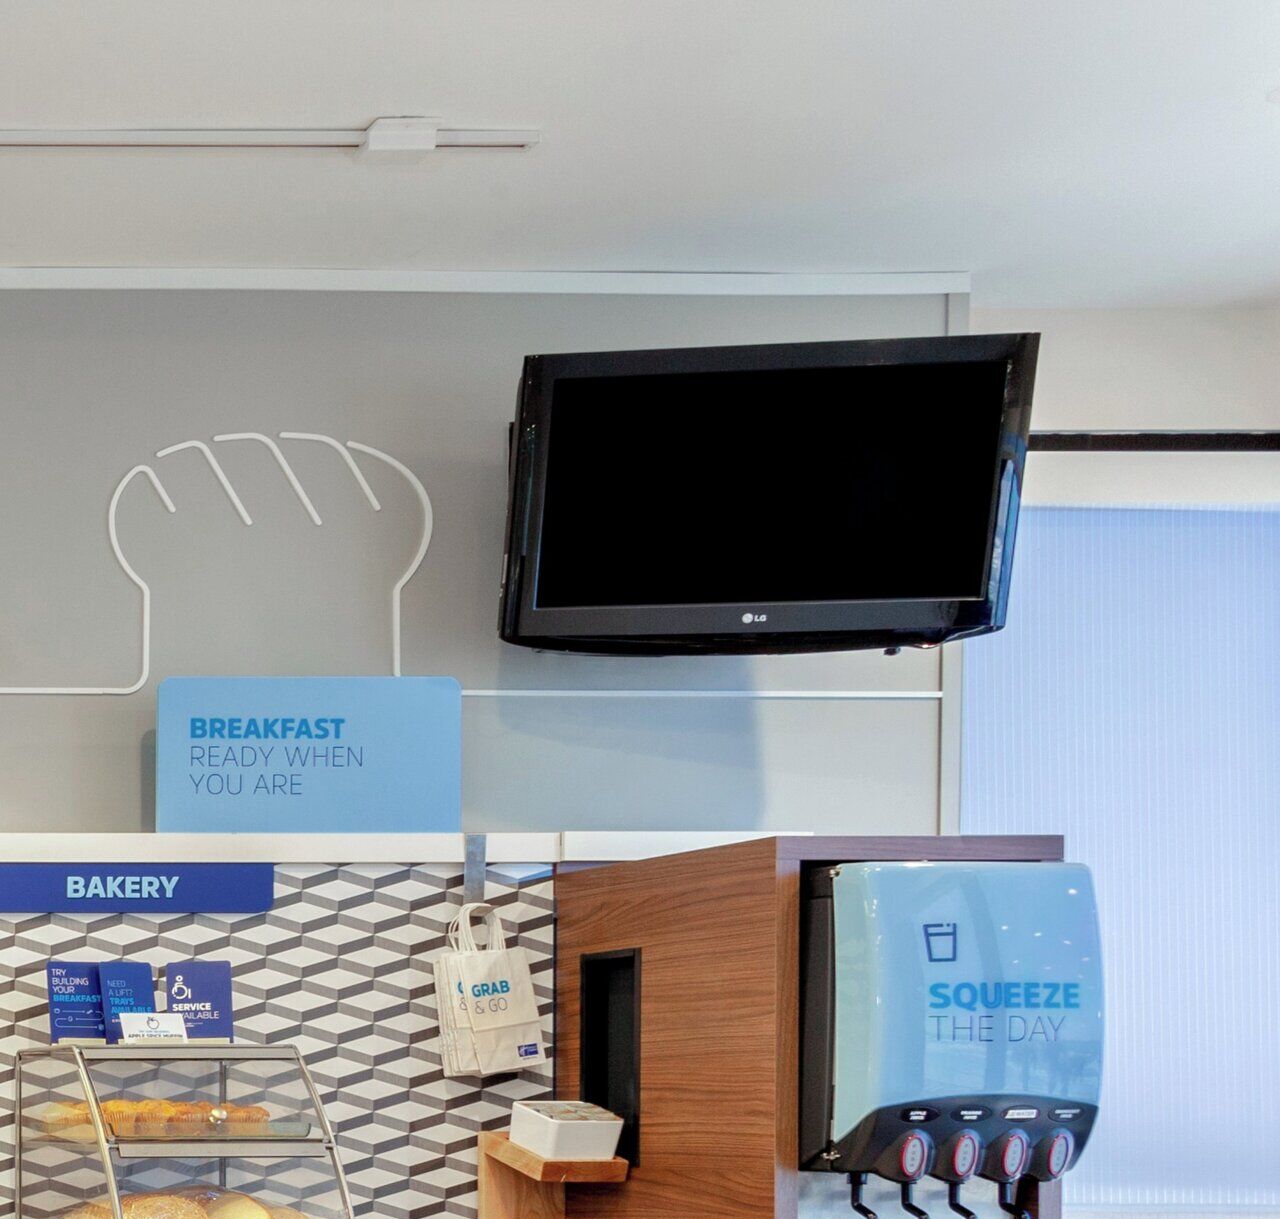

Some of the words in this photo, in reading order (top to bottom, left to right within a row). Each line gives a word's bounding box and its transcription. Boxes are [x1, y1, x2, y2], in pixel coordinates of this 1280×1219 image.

[754, 614, 768, 622] LG
[190, 717, 346, 740] BREAKFAST
[190, 746, 275, 767] READY
[284, 746, 363, 767] WHEN
[189, 774, 243, 795] YOU
[253, 774, 303, 795] ARE
[66, 876, 180, 900] BAKERY
[51, 968, 66, 976] TRY
[52, 977, 89, 986] BUILDING
[52, 986, 75, 994] YOUR
[107, 979, 126, 987] NEED
[472, 980, 510, 997] GRAB
[110, 997, 134, 1006] TRAYS
[475, 1000, 484, 1014] &
[488, 997, 508, 1013] GO
[928, 982, 1081, 1012] SQUEEZE
[172, 1003, 212, 1011] SERVICE
[928, 1015, 995, 1043] THE
[1008, 1015, 1066, 1043] DAY
